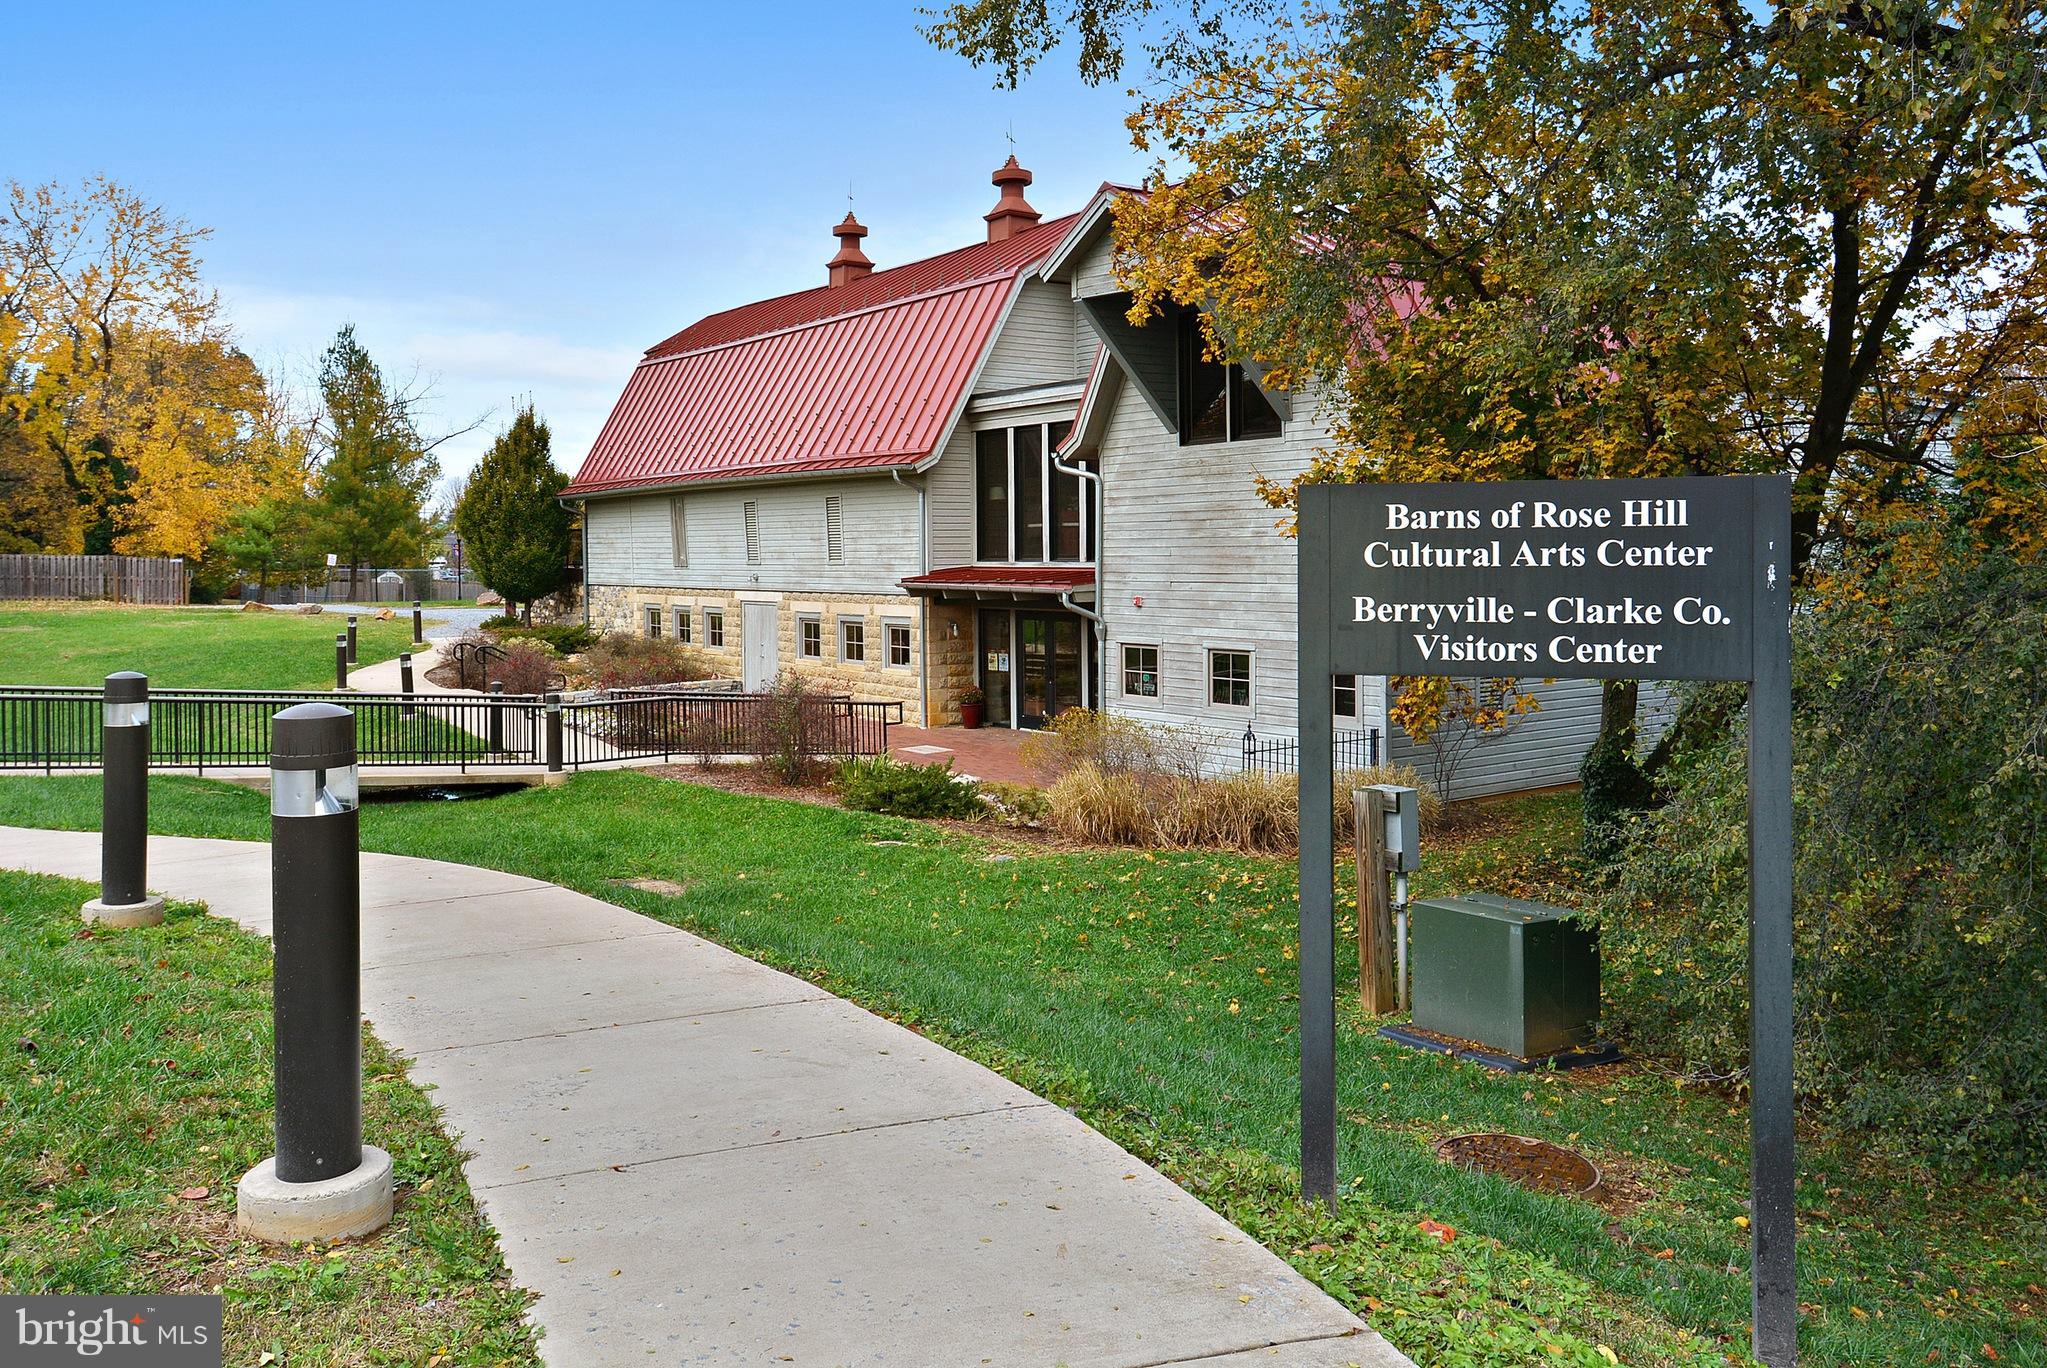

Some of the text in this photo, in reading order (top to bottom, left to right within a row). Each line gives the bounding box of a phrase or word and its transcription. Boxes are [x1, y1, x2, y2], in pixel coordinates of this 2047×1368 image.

[1385, 499, 1689, 530] Barns of Rose Hill
[1363, 539, 1714, 568] Cultural Arts Center
[1352, 596, 1514, 630] Berryville
[1547, 596, 1663, 625] Clarke
[1673, 597, 1731, 625] Co.
[1412, 634, 1663, 664] Visitors Center
